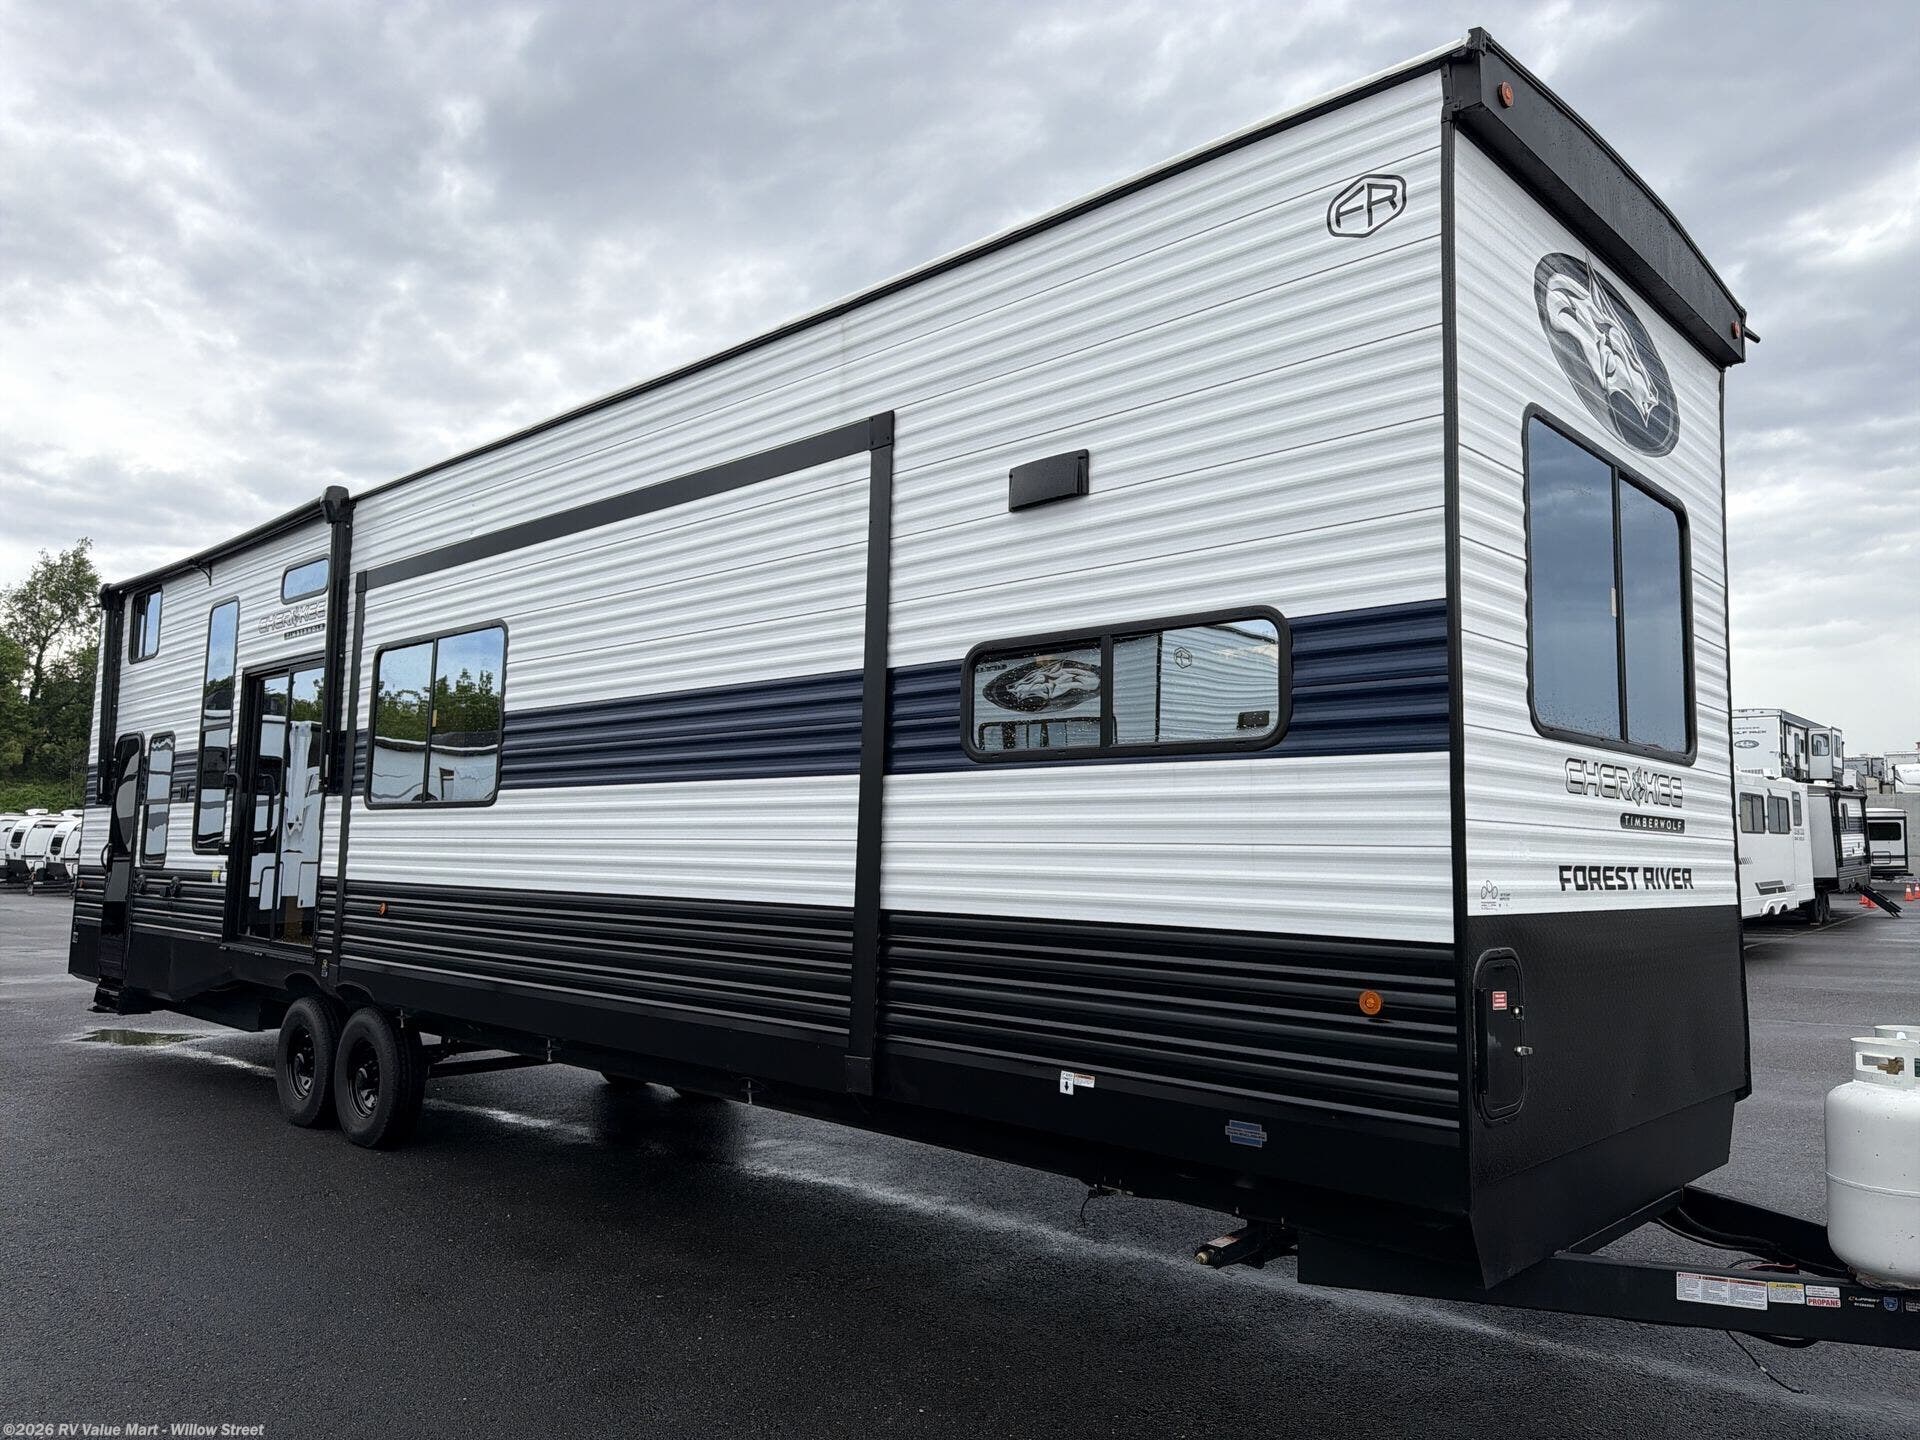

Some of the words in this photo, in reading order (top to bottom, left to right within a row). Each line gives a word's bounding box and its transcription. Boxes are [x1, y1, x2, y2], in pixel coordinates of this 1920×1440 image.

[1564, 757, 1684, 809] CHEROKEE
[1624, 814, 1683, 832] TIMBERWOLF
[1558, 865, 1639, 891] FOREST
[1642, 867, 1694, 890] RIVER
[1807, 1298, 1840, 1307] PROPANE
